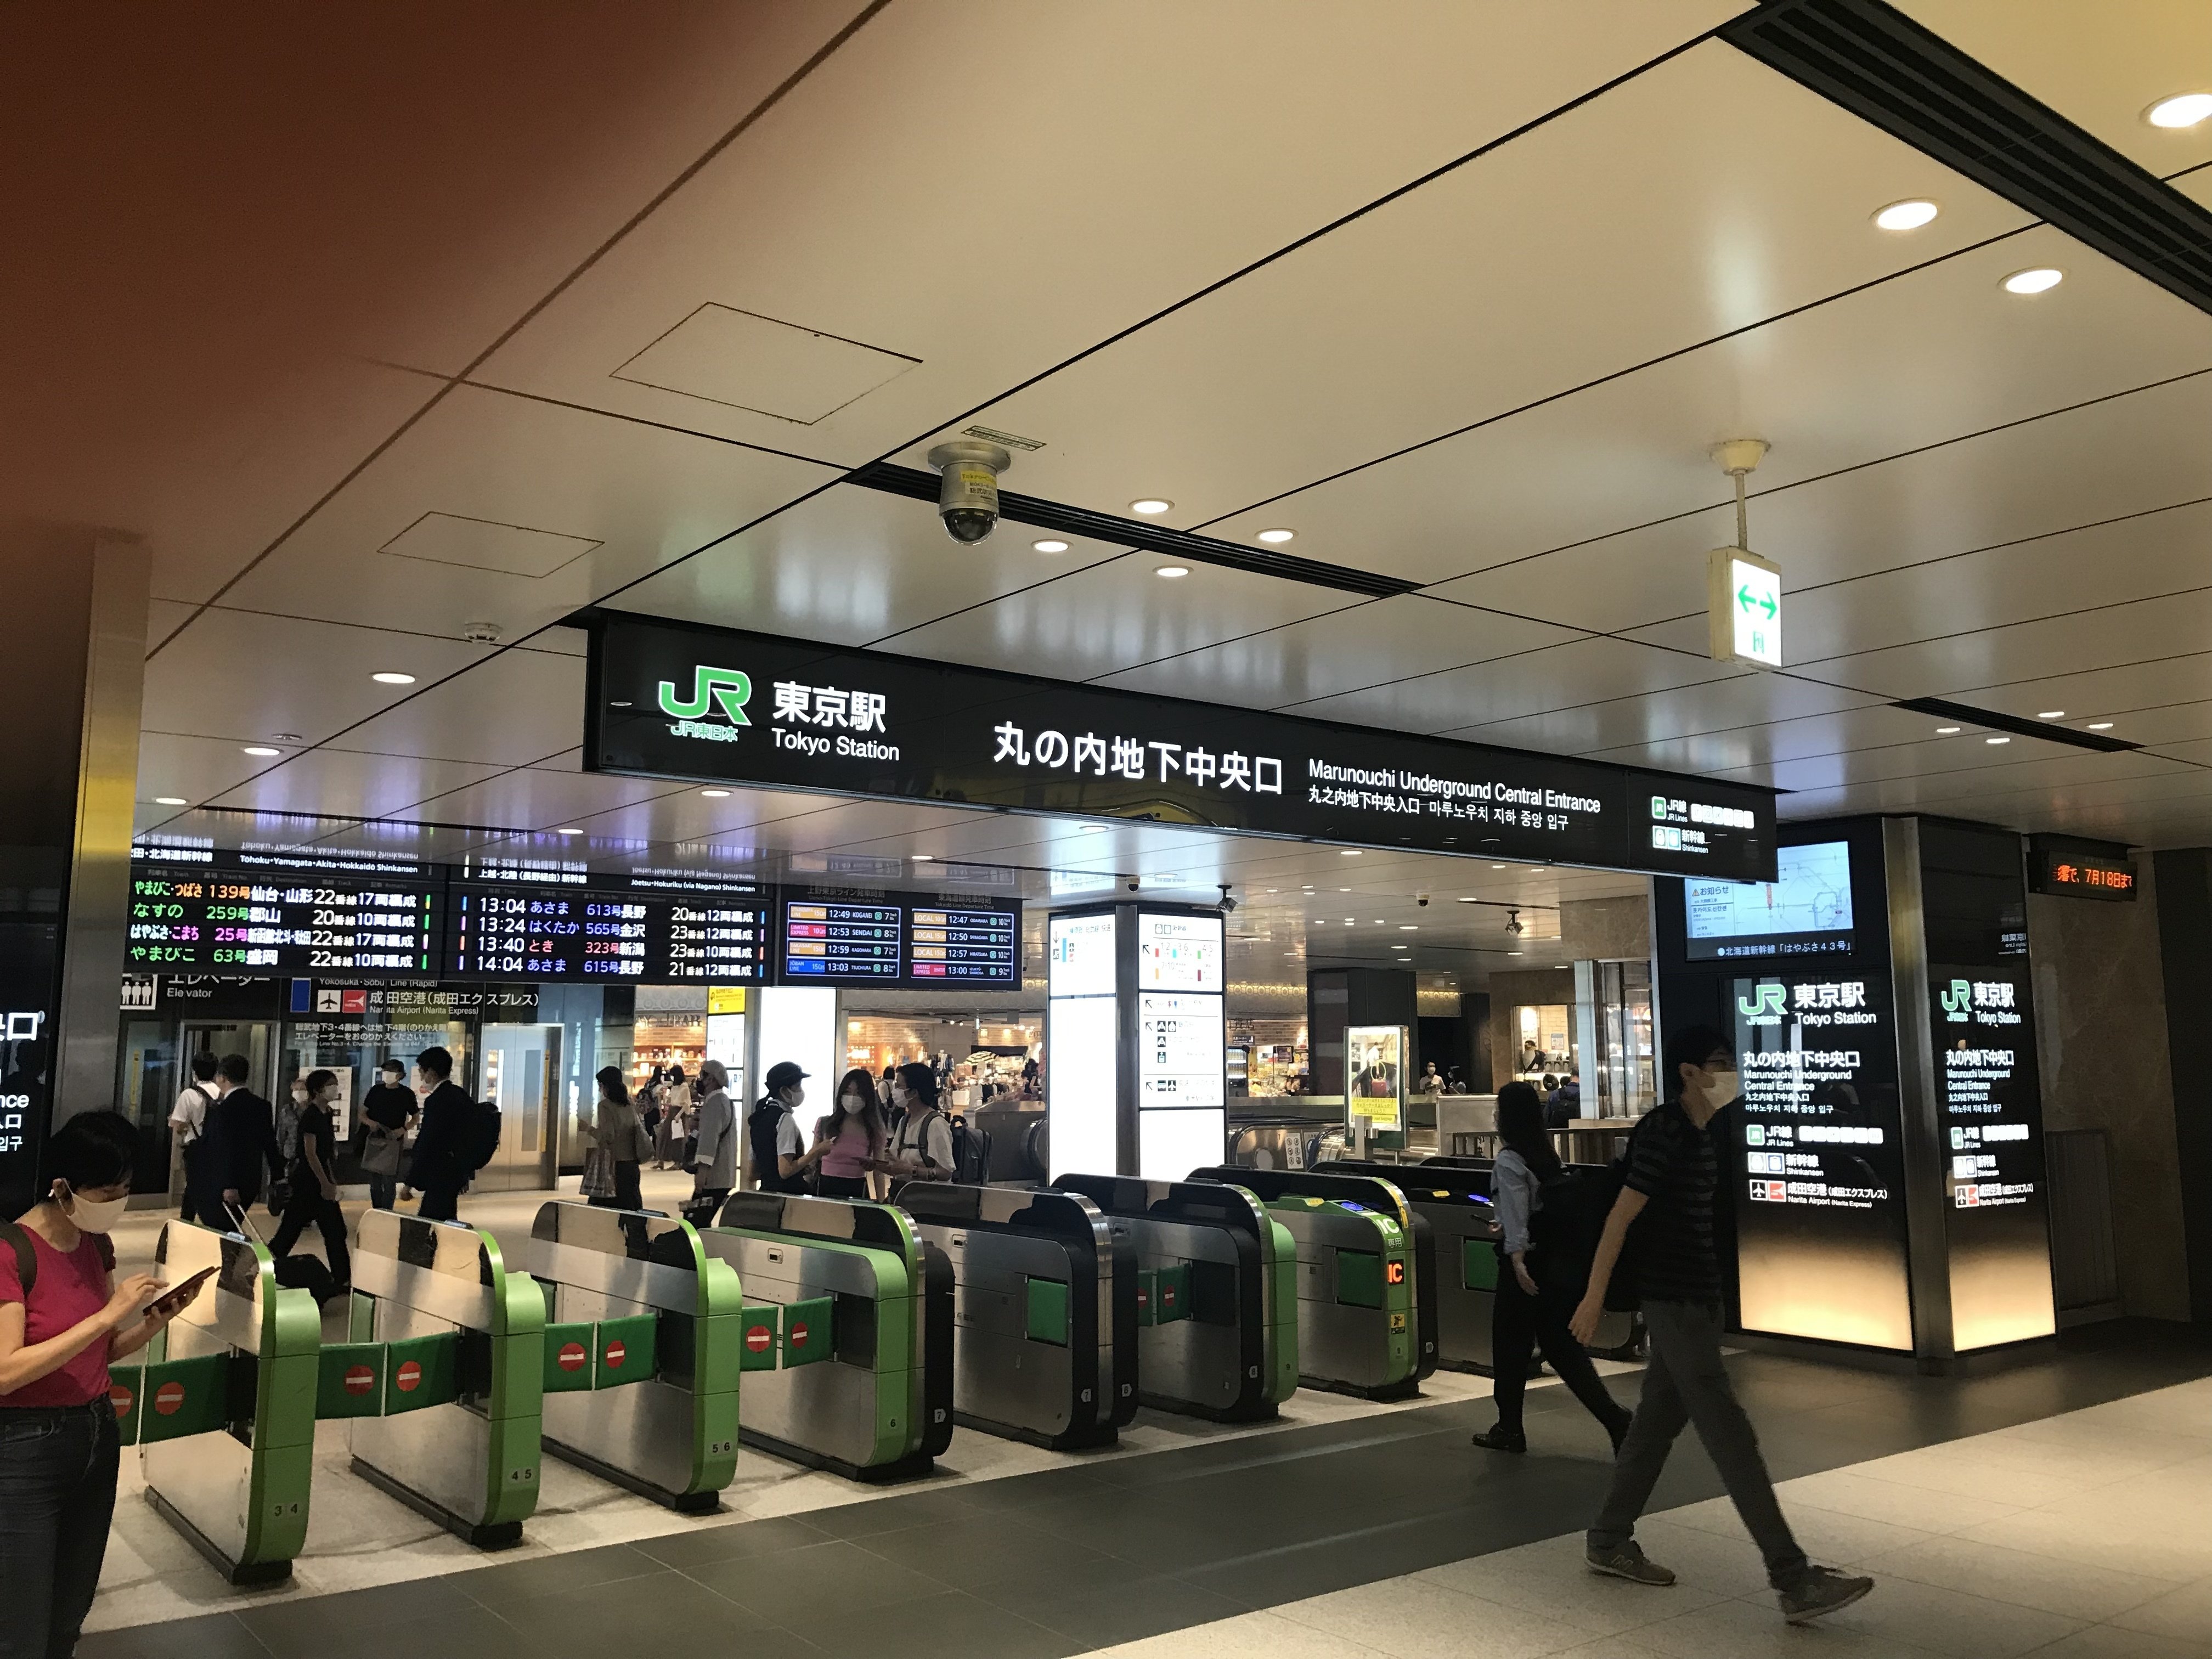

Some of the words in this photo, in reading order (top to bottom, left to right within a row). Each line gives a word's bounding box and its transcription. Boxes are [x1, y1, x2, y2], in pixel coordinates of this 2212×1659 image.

[658, 665, 752, 726] JR
[773, 681, 885, 733] 東京駅
[670, 721, 738, 742] JR東日本
[771, 727, 831, 755] Tokyo
[836, 733, 900, 761] Station
[994, 720, 1282, 794] 丸の内地下中央口
[1309, 758, 1395, 788] Marunouchi
[1400, 771, 1491, 801] Underground
[1495, 783, 1542, 806] Central
[1545, 790, 1600, 813] Entrance
[1308, 785, 1420, 815] 丸之内地下中央入口
[1667, 799, 1687, 813] JR線
[1430, 802, 1488, 822] 마루노우치
[1494, 806, 1516, 825] 지하
[1520, 810, 1542, 828] 중앙
[1547, 814, 1569, 831] 입구
[1675, 814, 1688, 823] Lines
[1682, 830, 1706, 844] 新幹線
[1682, 843, 1709, 854] Shinkansen
[377, 864, 418, 873] Shinkansen
[135, 880, 202, 898] やまびこ・つばさ
[210, 884, 250, 899] 139号
[251, 885, 313, 903] 仙台・山形
[313, 889, 357, 906] 22番線
[358, 892, 416, 908] 17両編成
[684, 881, 695, 890] (via
[696, 881, 721, 891] Nagano)
[722, 883, 755, 893] Shinkansen
[1700, 885, 1729, 895] お知らせ
[133, 902, 183, 918] なすの
[206, 906, 249, 921] 259号
[249, 907, 281, 923] 郡山
[313, 909, 356, 927] 20番線
[357, 913, 415, 928] 10両編成
[480, 897, 526, 913] 13:04
[530, 901, 569, 915] あさま
[586, 905, 621, 917] 613号
[620, 904, 646, 919] 長野
[671, 907, 706, 922] 20番線
[707, 910, 754, 923] 12両編成
[830, 910, 850, 918] 12:49
[949, 916, 968, 924] 12:47
[131, 923, 199, 940] はやぶさ・こまち
[215, 928, 247, 942] 25号
[311, 930, 354, 947] 22番線
[356, 933, 414, 949] 17両編成
[479, 917, 526, 933] 13:24
[529, 920, 580, 934] はくたか
[586, 923, 620, 935] 565号
[619, 923, 646, 938] 金沢
[670, 925, 706, 940] 23番線
[707, 928, 753, 941] 12両編成
[829, 928, 849, 936] 12:53
[478, 936, 524, 952] 13:40
[528, 939, 554, 953] とき
[585, 942, 619, 954] 323号
[619, 943, 645, 956] 新潟
[669, 944, 704, 958] 23番線
[706, 946, 753, 958] 10両編成
[828, 945, 849, 953] 12:59
[131, 945, 195, 962] やまびこ
[213, 949, 247, 963] 63号
[246, 949, 278, 966] 盛岡
[310, 950, 353, 967] 22番線
[354, 953, 413, 968] 10両編成
[477, 956, 523, 972] 14:04
[527, 958, 566, 972] あさま
[584, 961, 619, 973] 615号
[618, 960, 644, 975] 長野
[669, 962, 704, 977] 21番線
[705, 964, 752, 977] 12両編成
[828, 963, 849, 972] 13:03
[949, 966, 967, 974] 13:00
[1739, 984, 1788, 1014] JR
[1794, 982, 1865, 1008] 東京駅
[1941, 979, 1972, 1012] JR
[1973, 981, 2015, 1008] 東京駅
[397, 1007, 421, 1015] Airport
[423, 1007, 446, 1015] (Narita
[448, 1007, 478, 1016] Express)
[1976, 1011, 1997, 1026] Tokyo
[1998, 1012, 2021, 1024] Station
[1795, 1012, 1831, 1027] Tokyo
[1834, 1012, 1877, 1024] Station
[1743, 1051, 1860, 1068] 丸の内地下中央口
[1946, 1049, 2015, 1067] 丸の内地下中央口
[1744, 1070, 1792, 1079] Marunouchi
[1795, 1070, 1852, 1080] Underground
[1947, 1069, 1977, 1078] Marunouchi
[1978, 1069, 2010, 1080] Underground
[1745, 1081, 1775, 1091] Central
[1777, 1081, 1815, 1091] Entrance
[1948, 1080, 1966, 1090] Central
[1968, 1080, 1991, 1090] Entrance
[1745, 1092, 1809, 1102] 丸之内地下中央入口
[1766, 1126, 1792, 1138] JR線
[1776, 1139, 1794, 1147] Lines
[1786, 1154, 1819, 1168] 新幹線
[1786, 1167, 1824, 1176] Shinkansen
[1788, 1196, 1807, 1204] Narita
[1809, 1197, 1830, 1206] Airport
[1849, 1200, 1872, 1208] Express)
[1376, 1217, 1400, 1234] IC
[1387, 1263, 1403, 1283] IC
[889, 1418, 896, 1429] 6
[936, 1411, 943, 1423] 7
[712, 1442, 719, 1454] 5
[723, 1441, 731, 1453] 6
[511, 1469, 520, 1481] 4
[524, 1468, 532, 1480] 5
[274, 1504, 283, 1516] 3
[290, 1503, 298, 1515] 4
